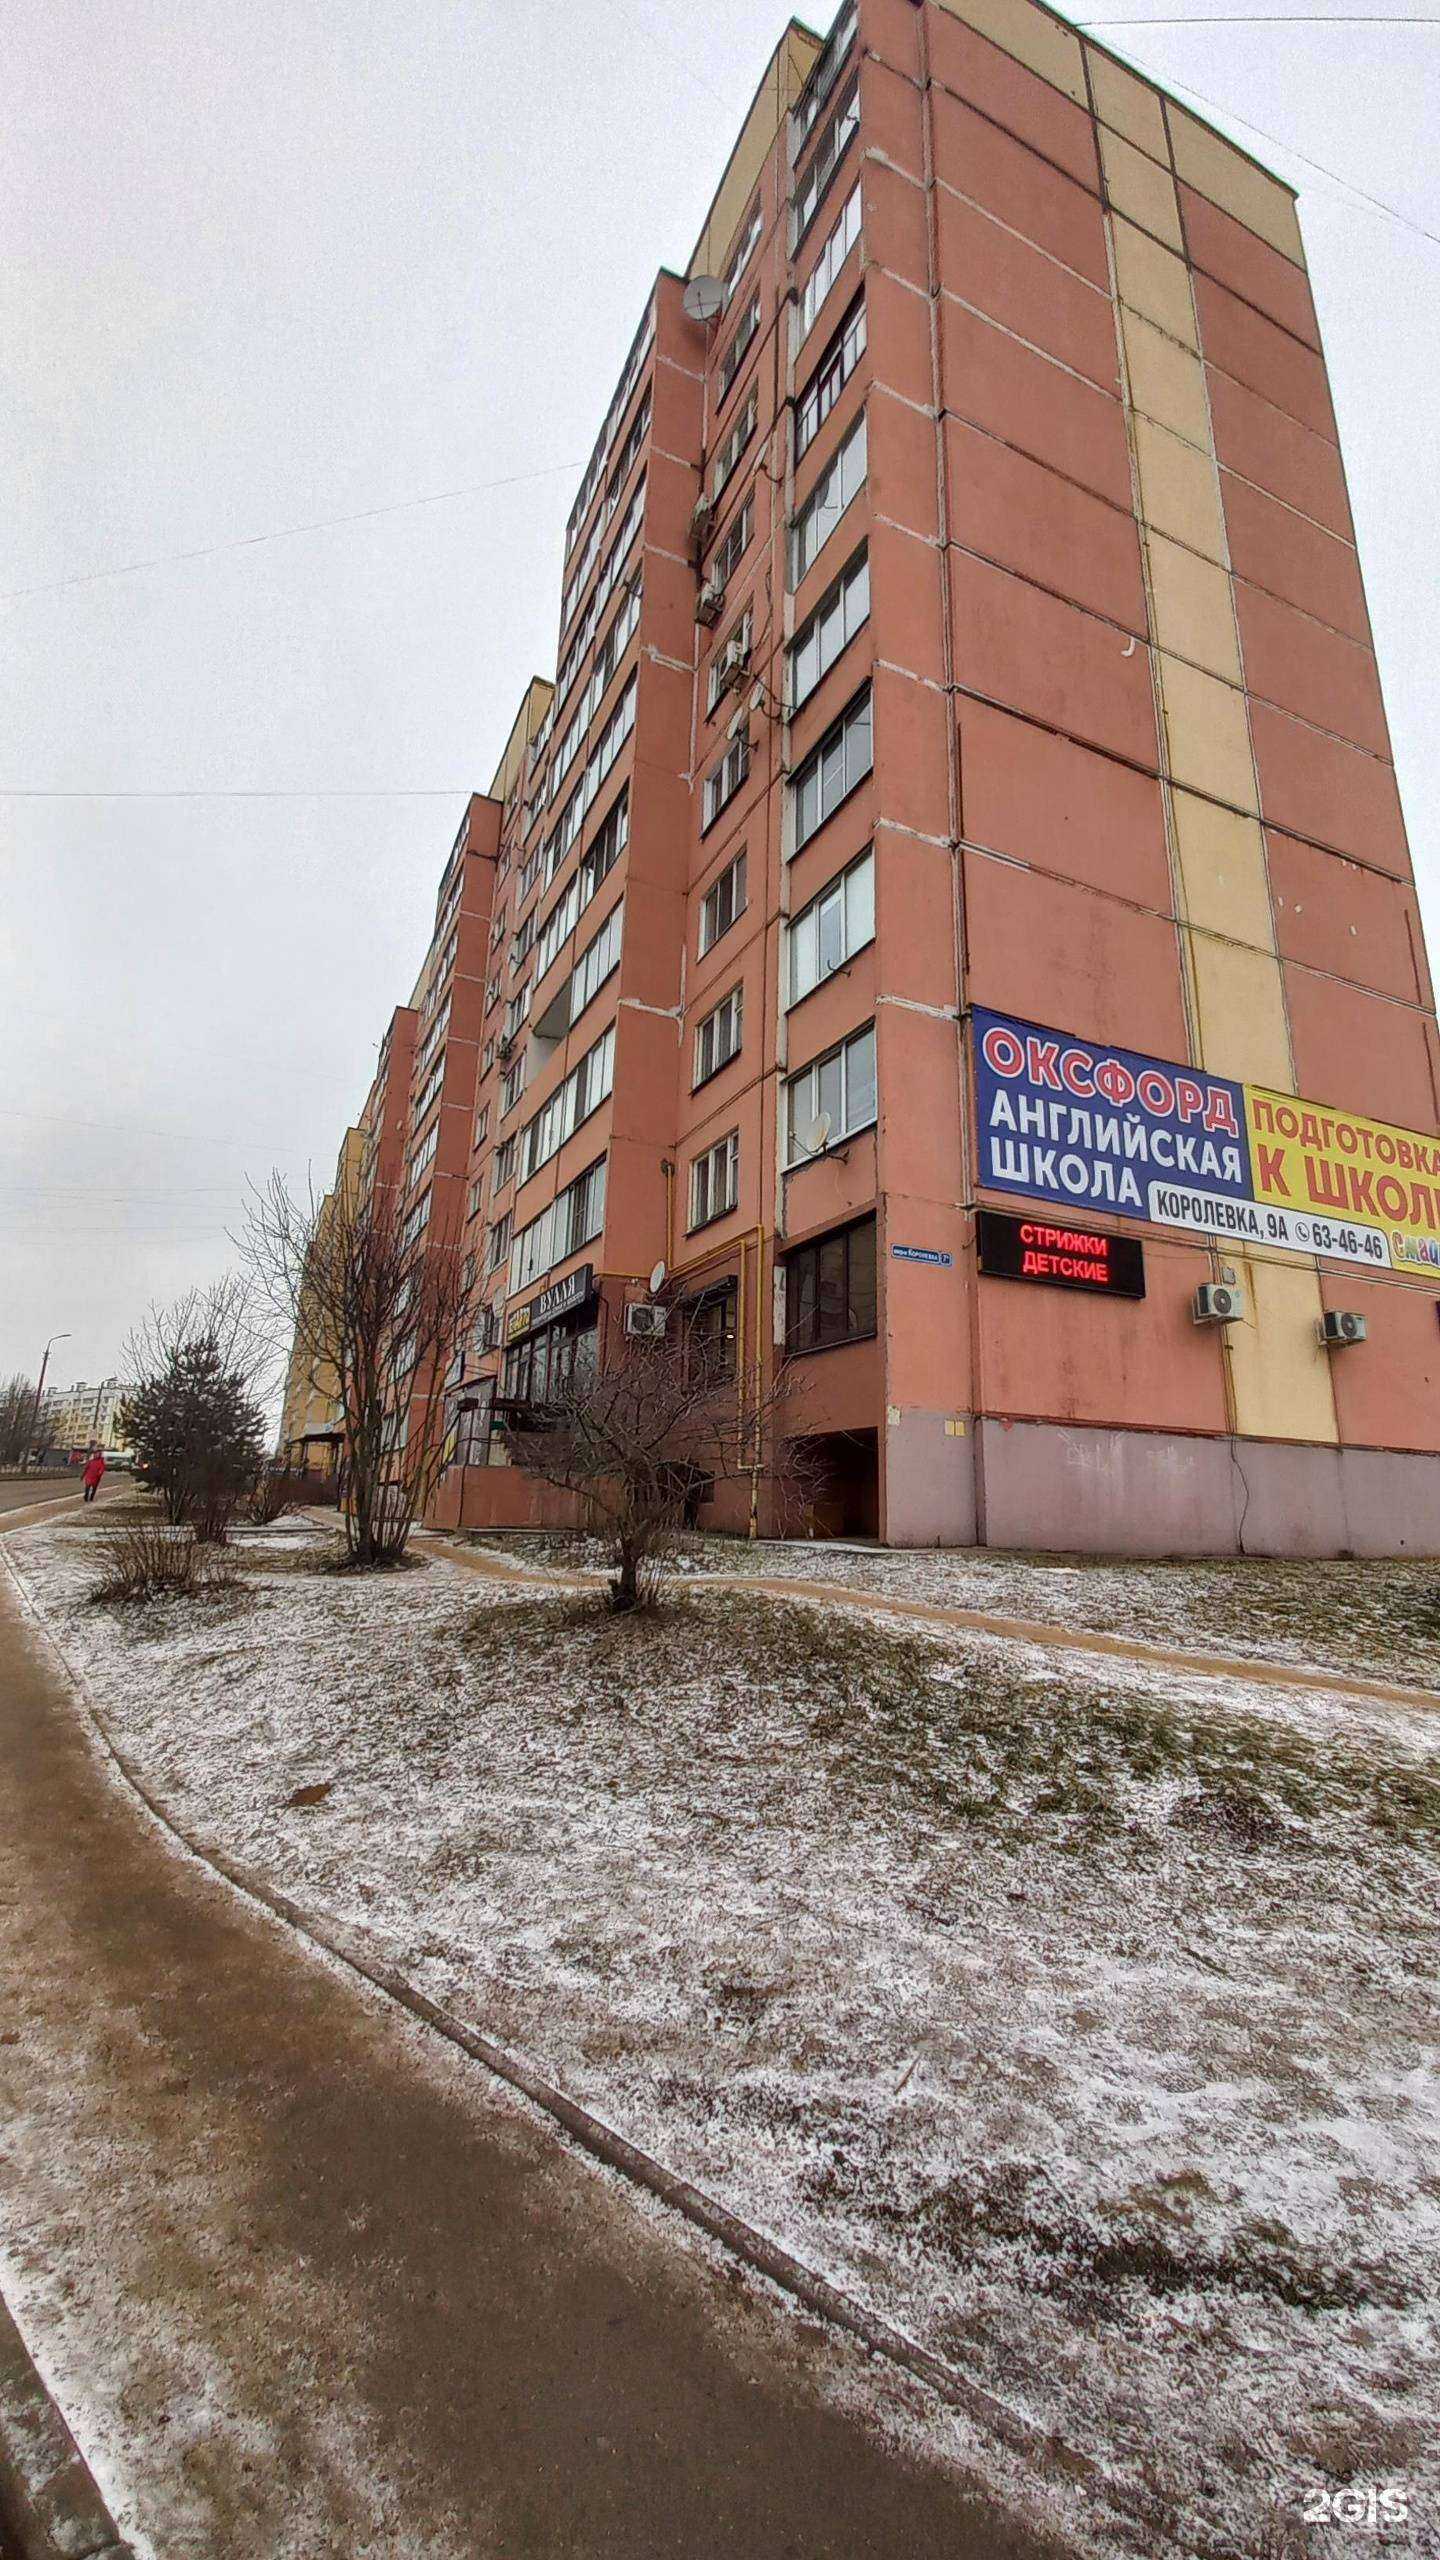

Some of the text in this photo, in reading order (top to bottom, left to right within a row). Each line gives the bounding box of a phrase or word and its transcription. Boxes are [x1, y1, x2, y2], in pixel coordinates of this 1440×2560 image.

[983, 1027, 1239, 1139] ОКСФОРД
[989, 1088, 1242, 1183] АНГЛИЙСКАЯ
[990, 1136, 1143, 1207] ШКОЛА
[1257, 1144, 1440, 1230] К ШКОЛ
[1020, 1224, 1108, 1257] СТРИЖКИ
[1156, 1189, 1383, 1260] КОРОЛЕВКА, 9А 63-46-46
[1023, 1251, 1109, 1282] ДЕТСКИЕ
